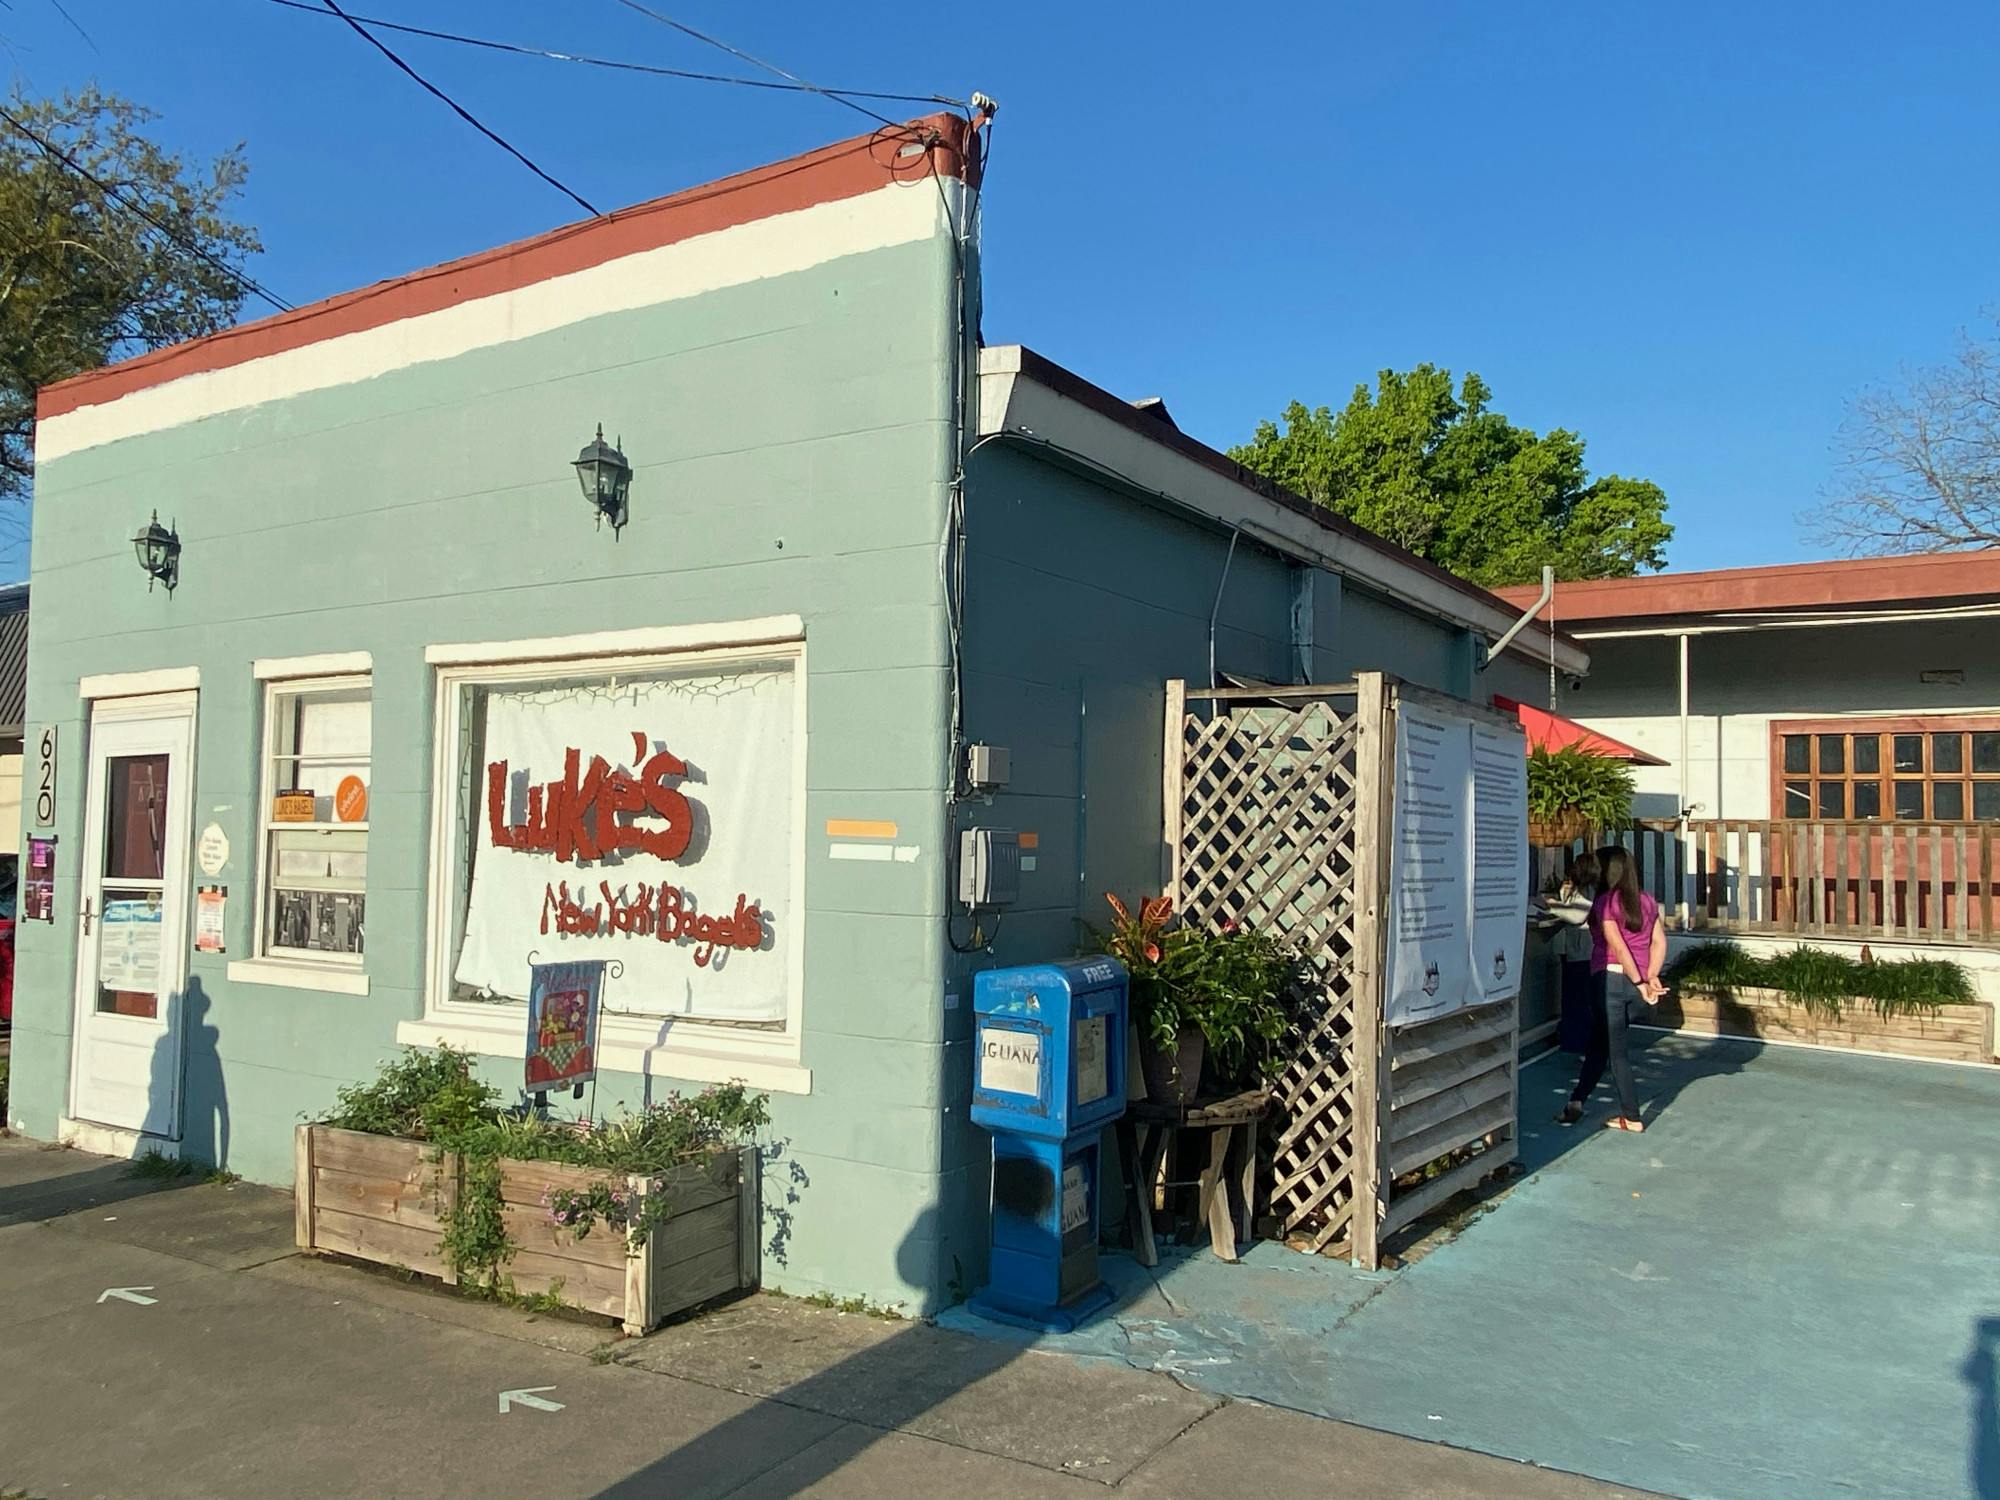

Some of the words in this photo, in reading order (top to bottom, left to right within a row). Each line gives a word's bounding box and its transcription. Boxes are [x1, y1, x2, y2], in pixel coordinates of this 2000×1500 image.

[37, 729, 52, 821] 620
[540, 880, 602, 936] New
[600, 880, 654, 936] York
[656, 880, 763, 967] Bagels
[1082, 964, 1114, 984] FREE
